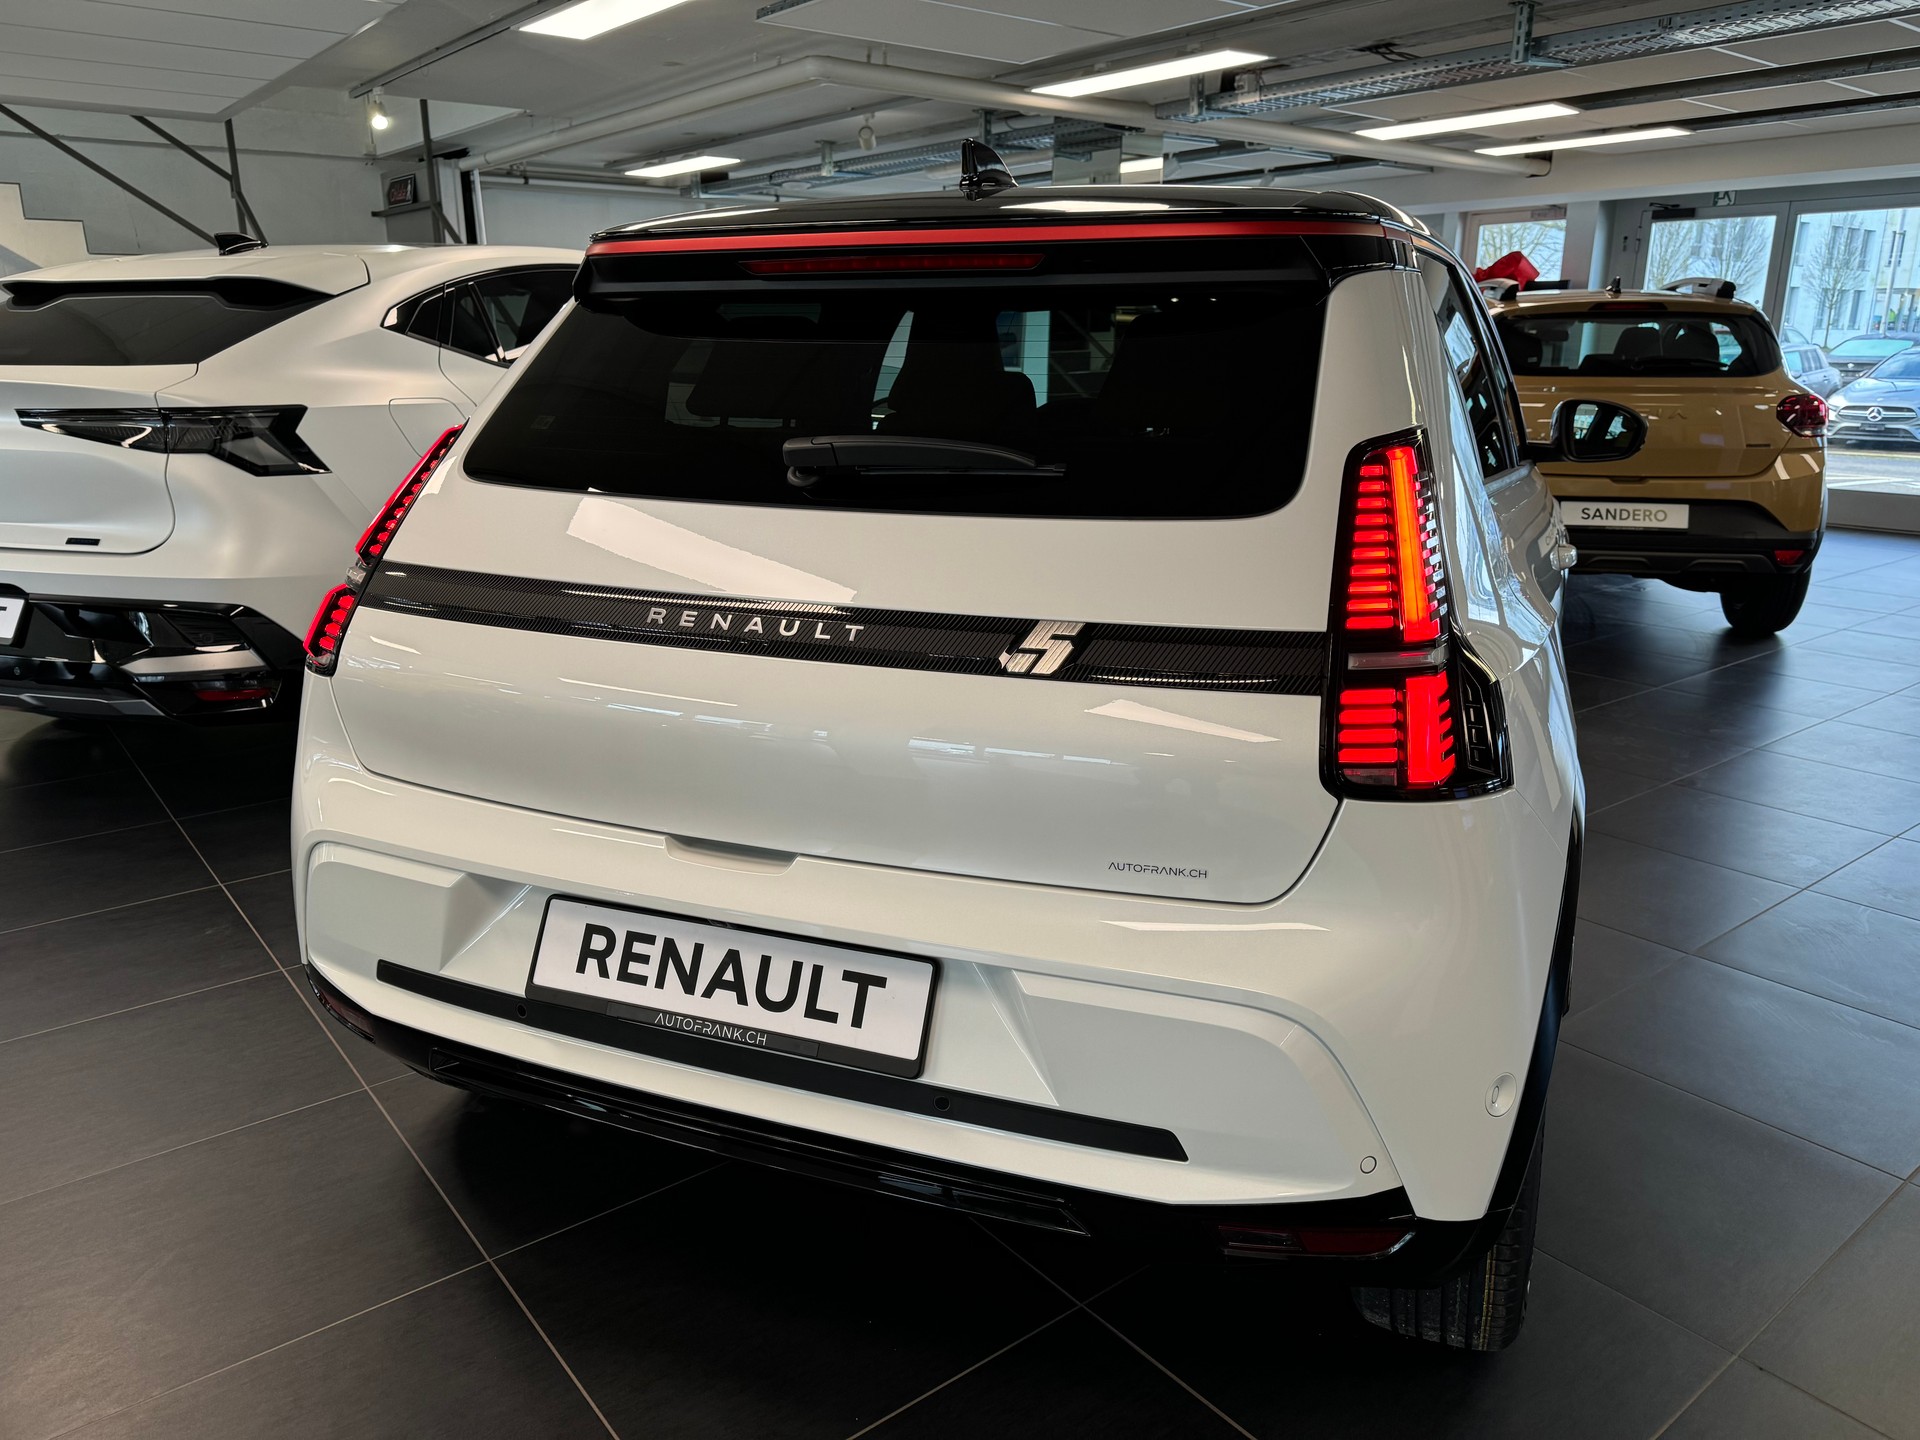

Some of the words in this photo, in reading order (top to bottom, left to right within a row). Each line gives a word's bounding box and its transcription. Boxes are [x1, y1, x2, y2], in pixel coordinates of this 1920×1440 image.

[1581, 507, 1668, 522] SANDERO
[646, 607, 865, 643] RENAULT
[1000, 620, 1086, 675] 5
[1108, 861, 1208, 879] AUTOFRANK.CH
[575, 922, 887, 1029] RENAULT
[654, 1012, 768, 1046] AUTOFRANK.CH
